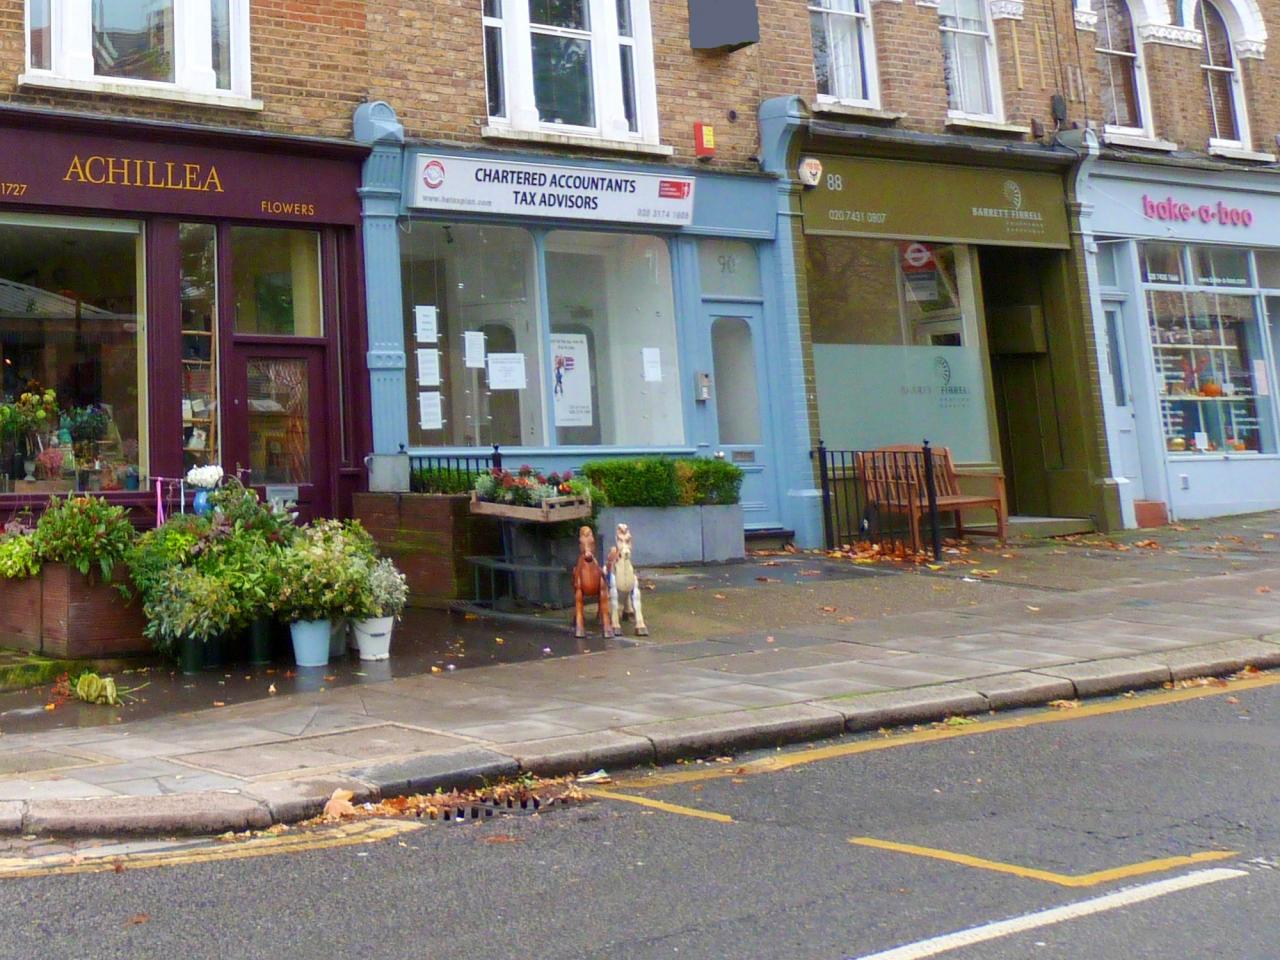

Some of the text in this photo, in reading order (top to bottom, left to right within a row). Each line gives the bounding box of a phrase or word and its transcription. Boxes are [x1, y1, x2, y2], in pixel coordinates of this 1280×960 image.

[63, 154, 224, 192] ACHILLEA
[475, 167, 546, 187] CHARTERED
[549, 172, 636, 193] ACCOUNTANTS
[1, 182, 27, 196] 1727
[827, 174, 842, 191] 88
[261, 200, 315, 216] FLOWERS
[513, 191, 598, 210] TAX ADVISORS
[829, 209, 844, 221] 020
[972, 207, 1009, 218] BARRETT
